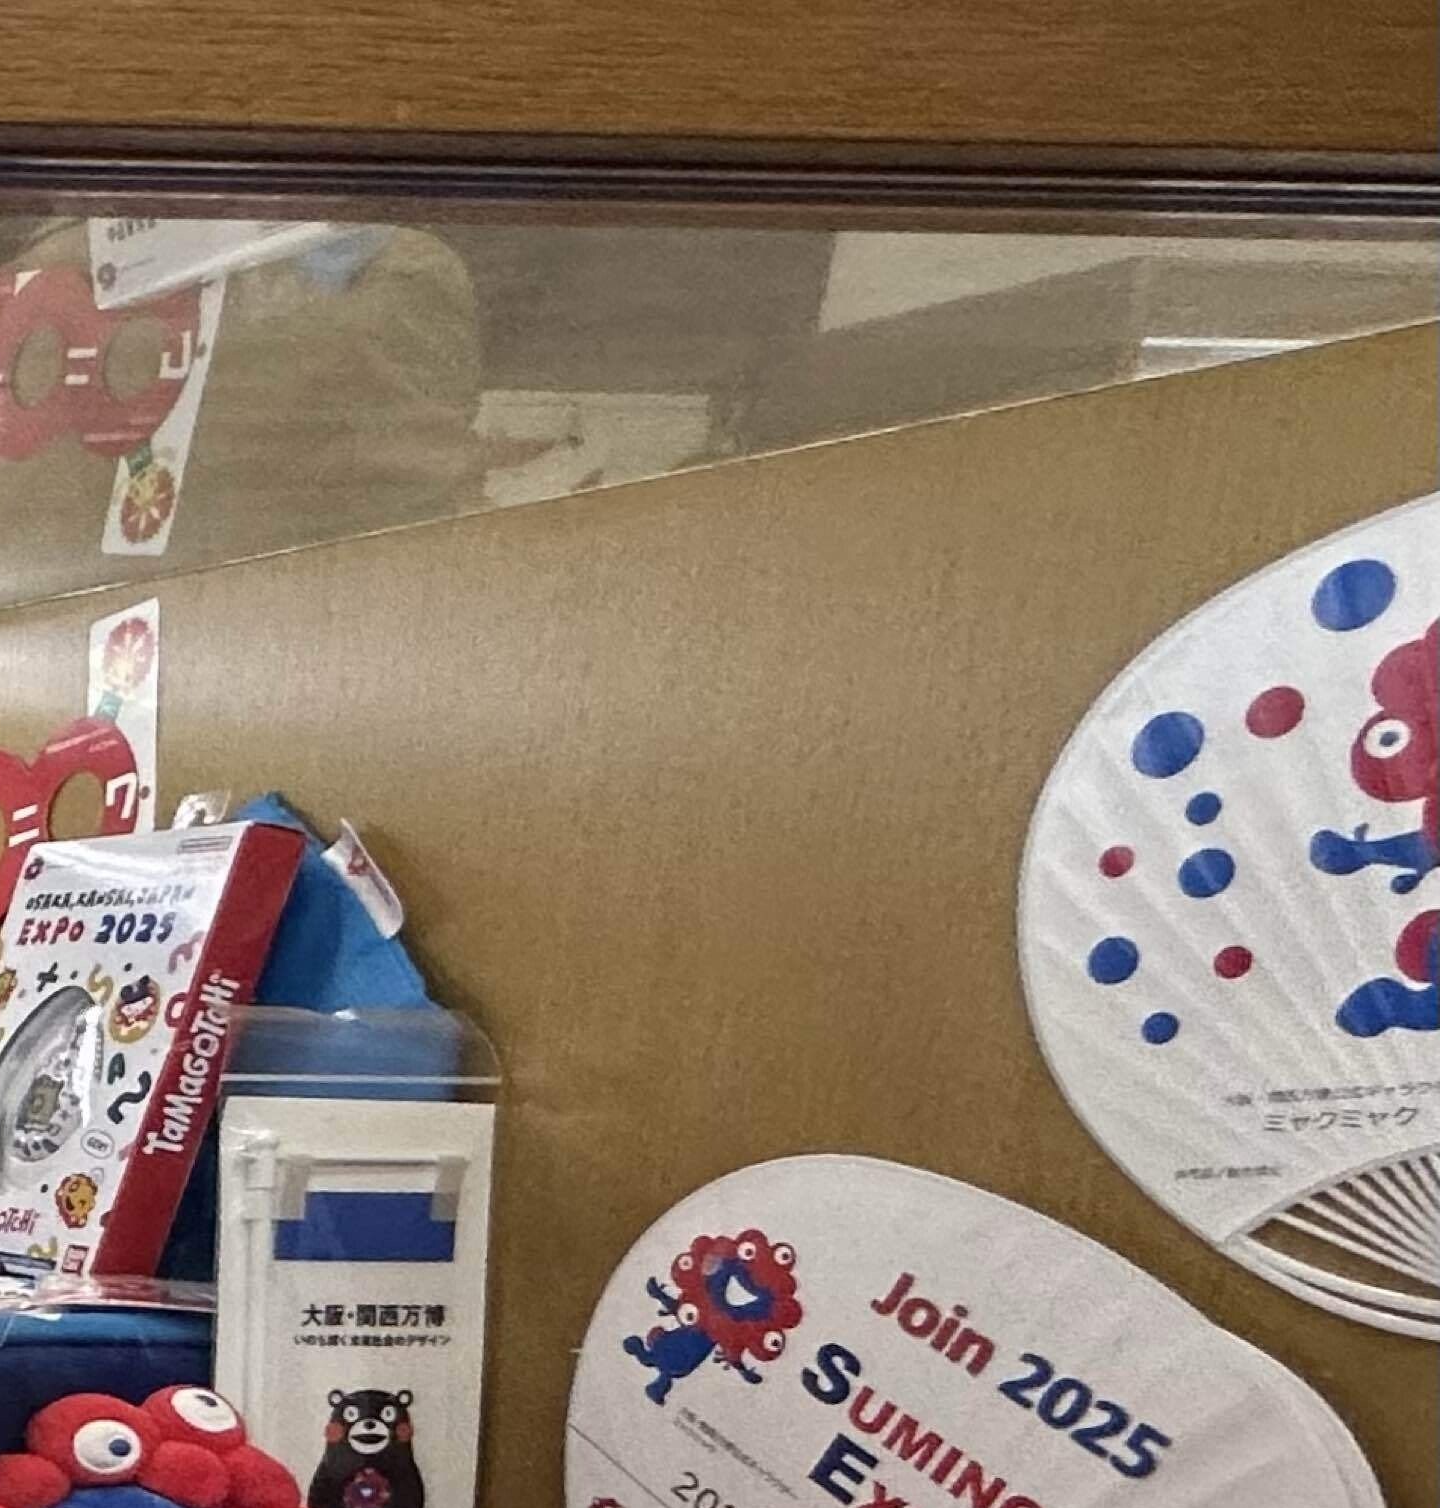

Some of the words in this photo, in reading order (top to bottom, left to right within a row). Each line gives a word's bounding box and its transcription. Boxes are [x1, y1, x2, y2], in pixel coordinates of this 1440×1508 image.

[16, 916, 86, 947] EXPO
[93, 912, 178, 946] 2025
[1263, 1105, 1419, 1133] ミャクミャク
[301, 1303, 446, 1328] 大阪・関西万博
[871, 1272, 996, 1377] Join
[997, 1352, 1172, 1480] 2025
